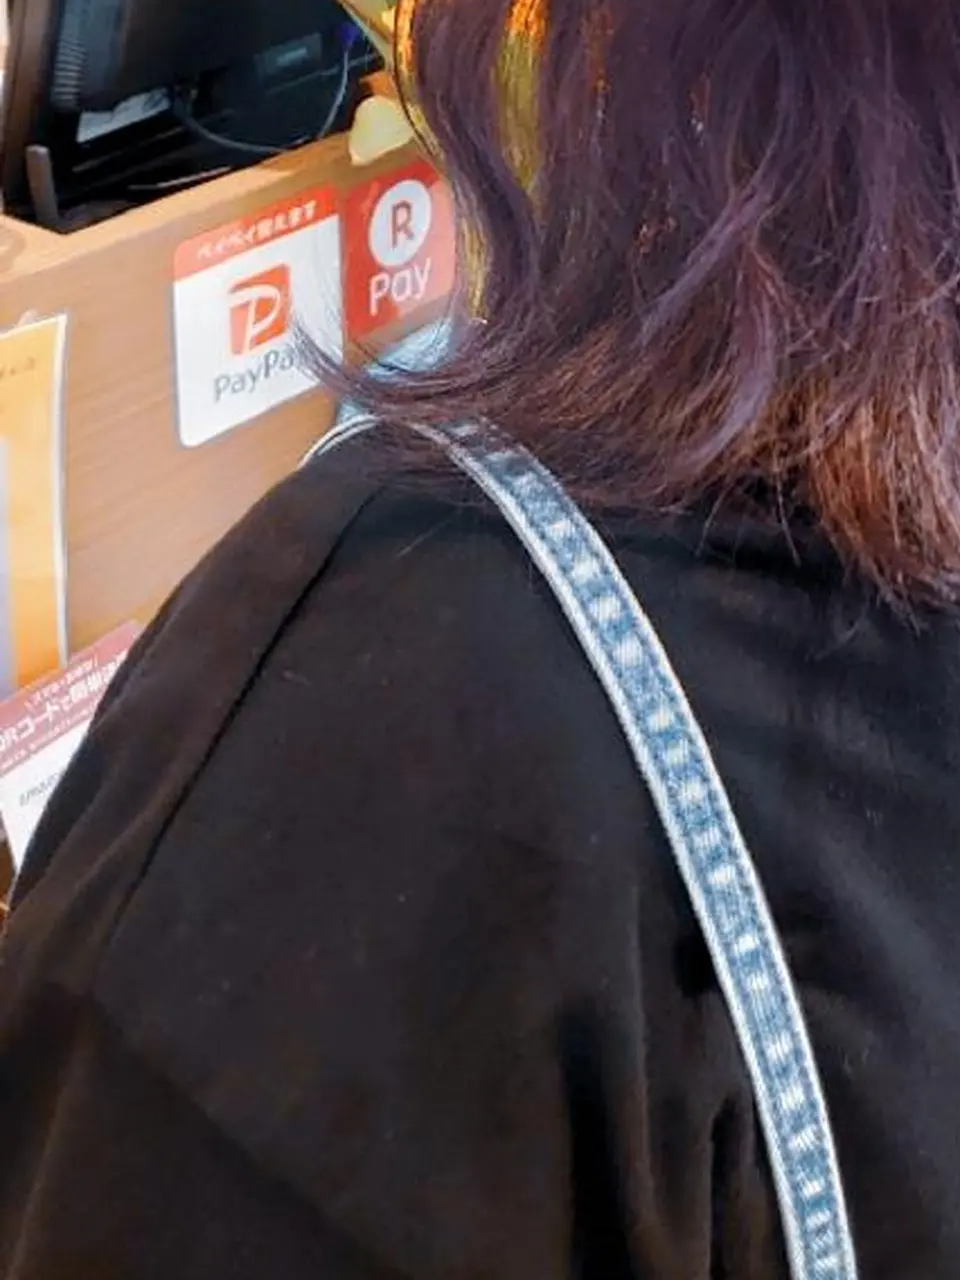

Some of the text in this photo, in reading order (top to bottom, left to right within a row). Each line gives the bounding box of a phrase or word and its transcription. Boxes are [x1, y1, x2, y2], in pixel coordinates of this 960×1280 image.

[388, 200, 415, 248] R
[369, 257, 431, 317] Pay
[214, 346, 302, 404] PayPa
